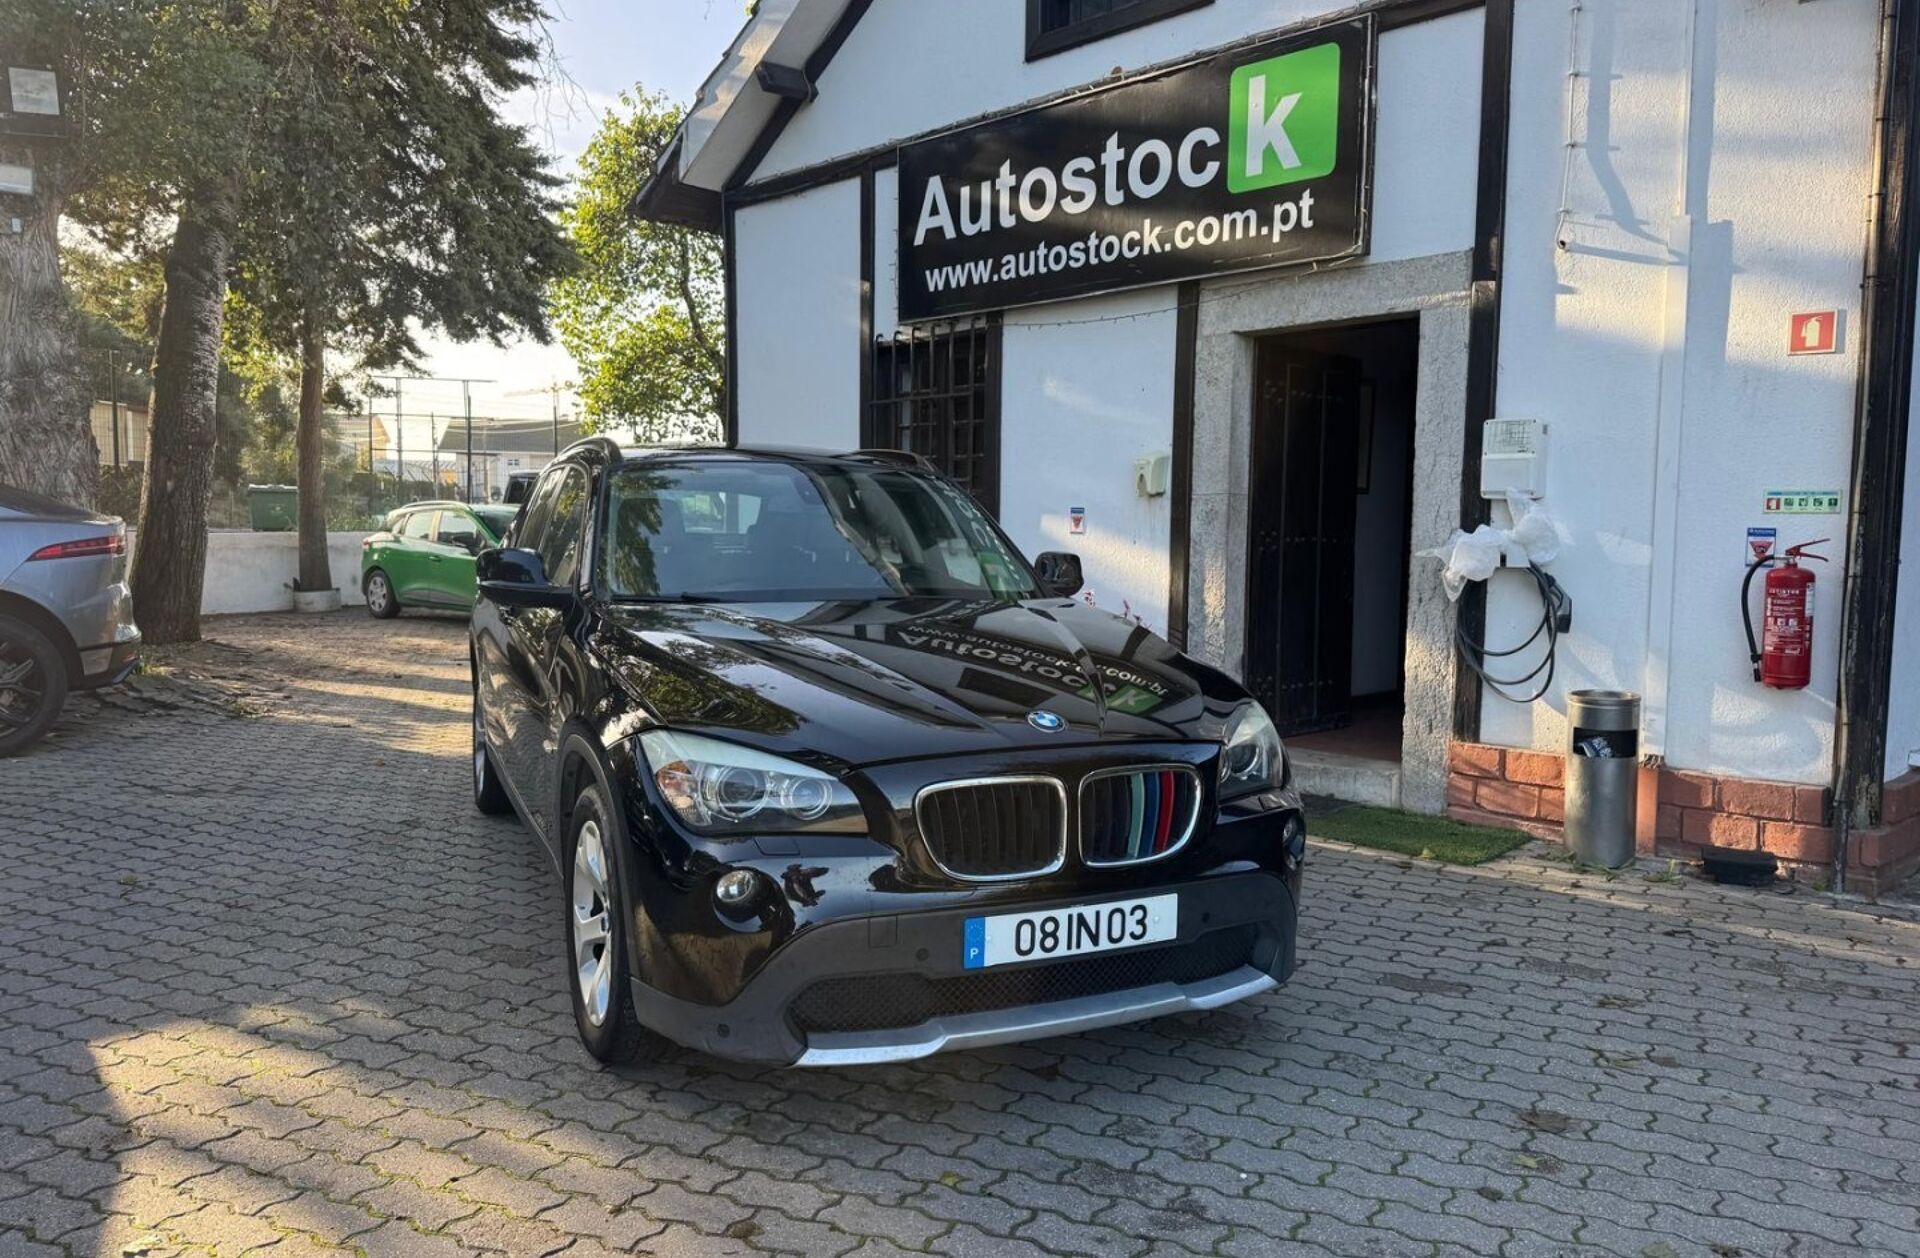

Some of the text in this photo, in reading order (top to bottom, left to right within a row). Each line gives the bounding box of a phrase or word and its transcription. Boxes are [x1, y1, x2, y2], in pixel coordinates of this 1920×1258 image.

[913, 73, 1303, 247] Autostock
[925, 188, 1315, 293] www.autostock.com.pt
[970, 948, 979, 960] P
